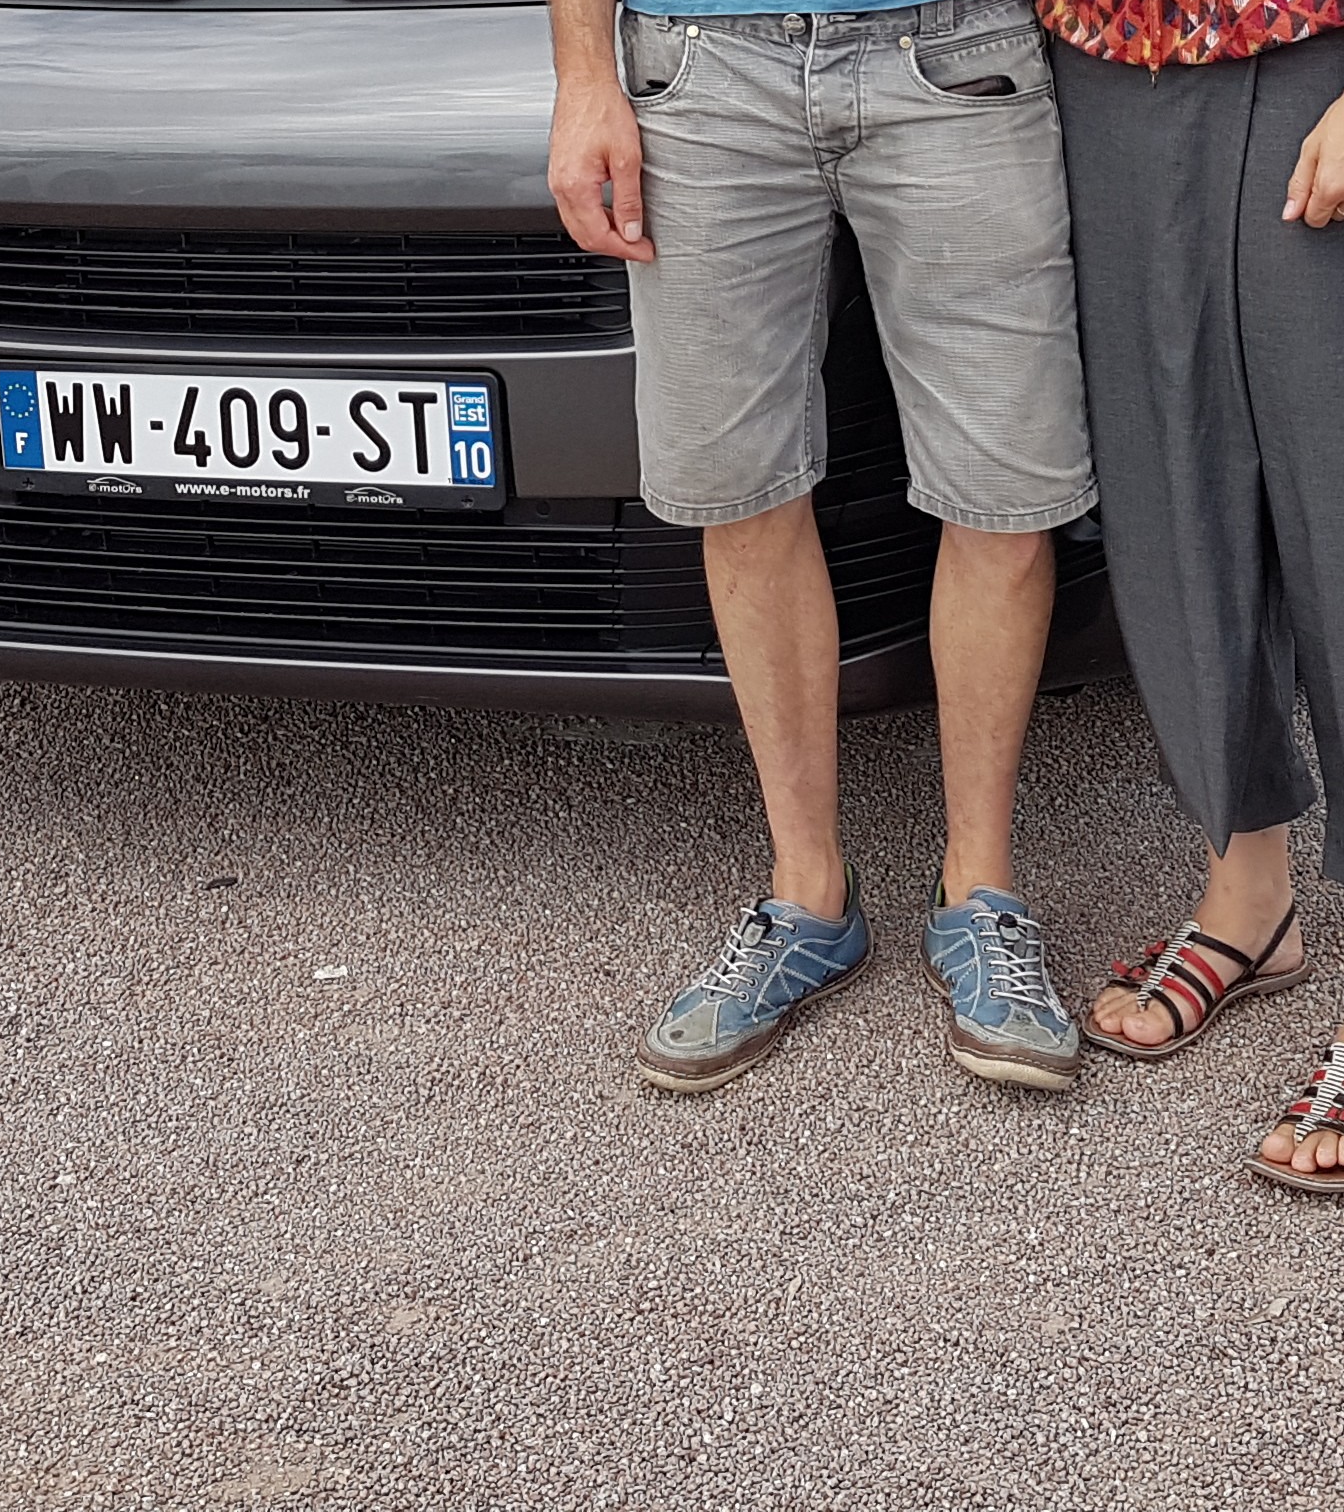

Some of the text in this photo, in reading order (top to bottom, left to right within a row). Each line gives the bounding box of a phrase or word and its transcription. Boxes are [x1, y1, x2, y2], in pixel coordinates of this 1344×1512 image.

[453, 394, 485, 404] Grand
[454, 404, 486, 422] Est
[15, 431, 28, 455] F
[454, 440, 492, 479] 10
[175, 482, 311, 500] www.e-motors.fr
